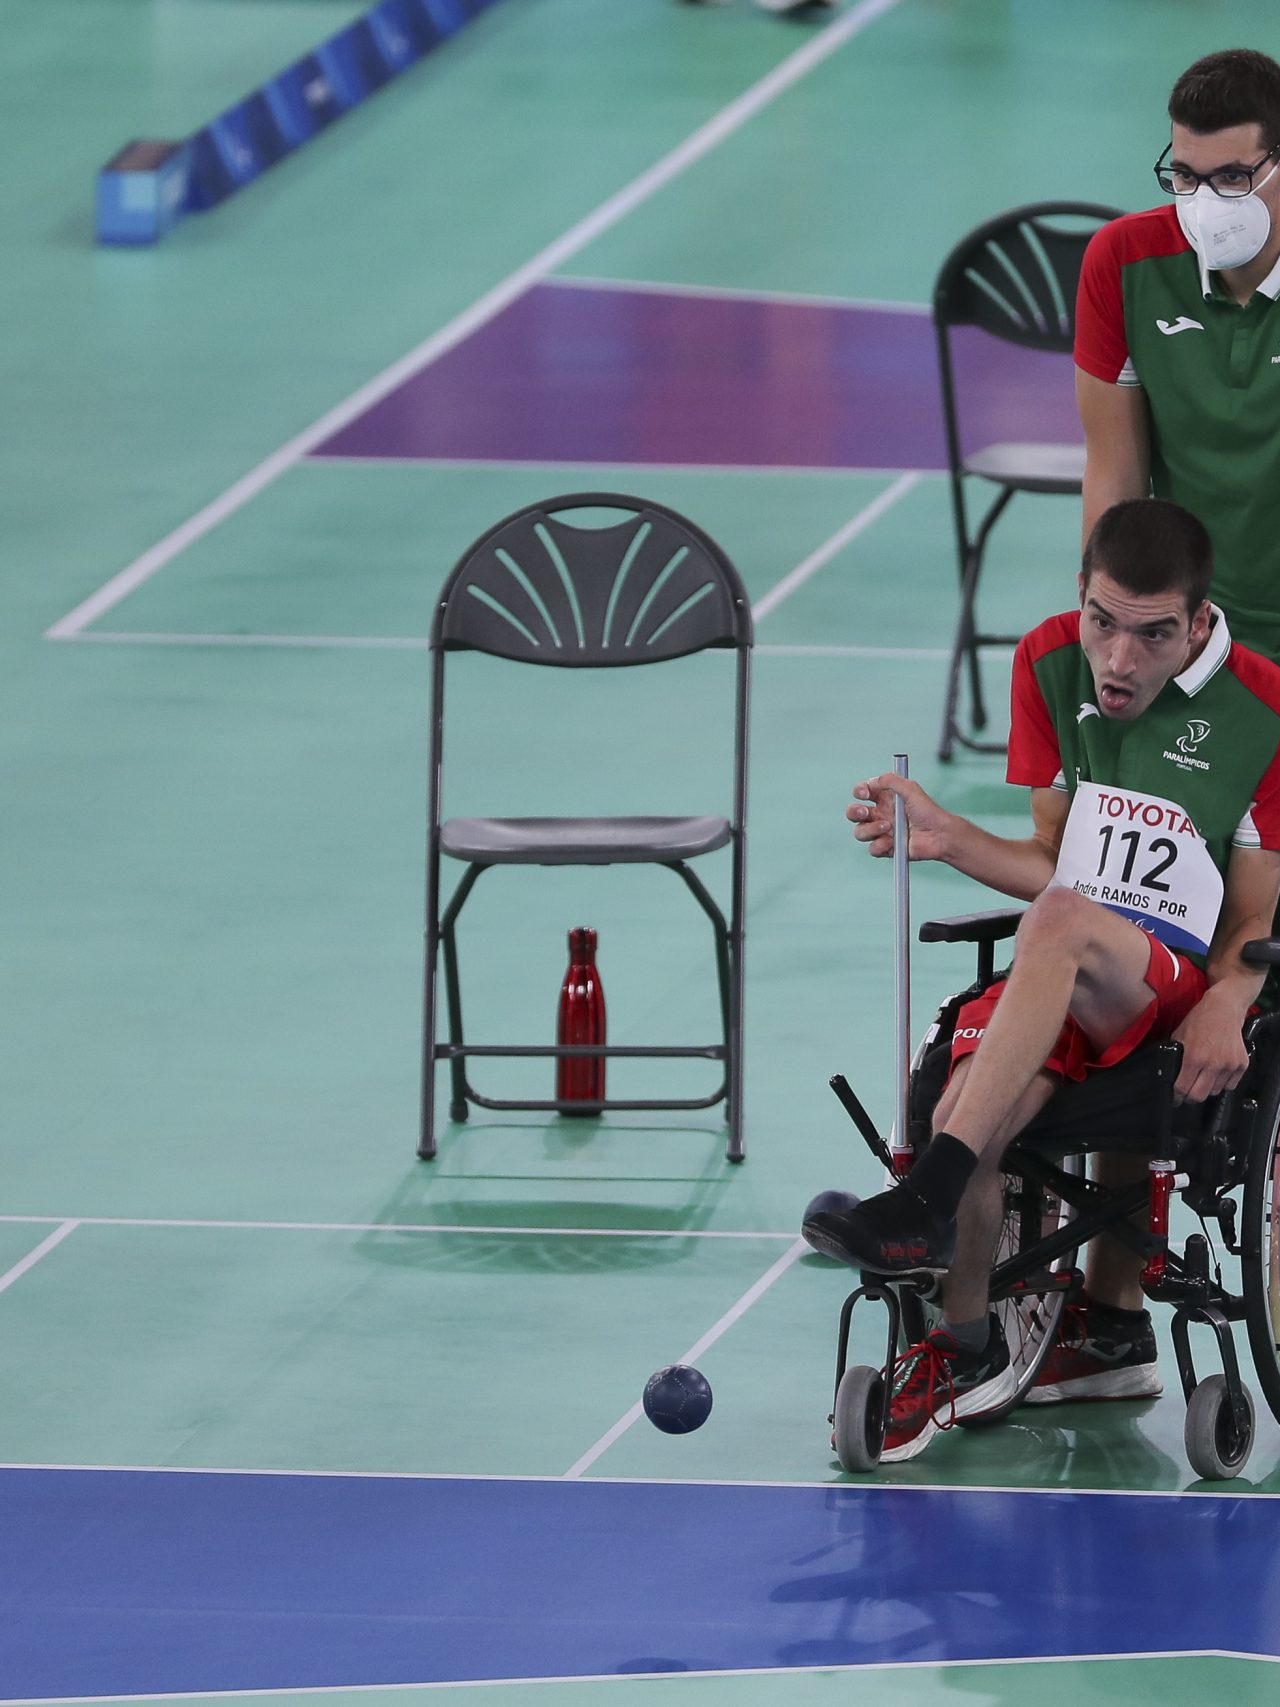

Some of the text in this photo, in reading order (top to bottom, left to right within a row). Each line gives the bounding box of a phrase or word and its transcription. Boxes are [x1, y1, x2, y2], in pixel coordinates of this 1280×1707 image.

[1163, 750, 1210, 770] PARALÍMPICOS
[1097, 793, 1197, 839] TOYOTA
[1097, 825, 1179, 893] 112
[1073, 879, 1188, 918] Andre RAMOS POR
